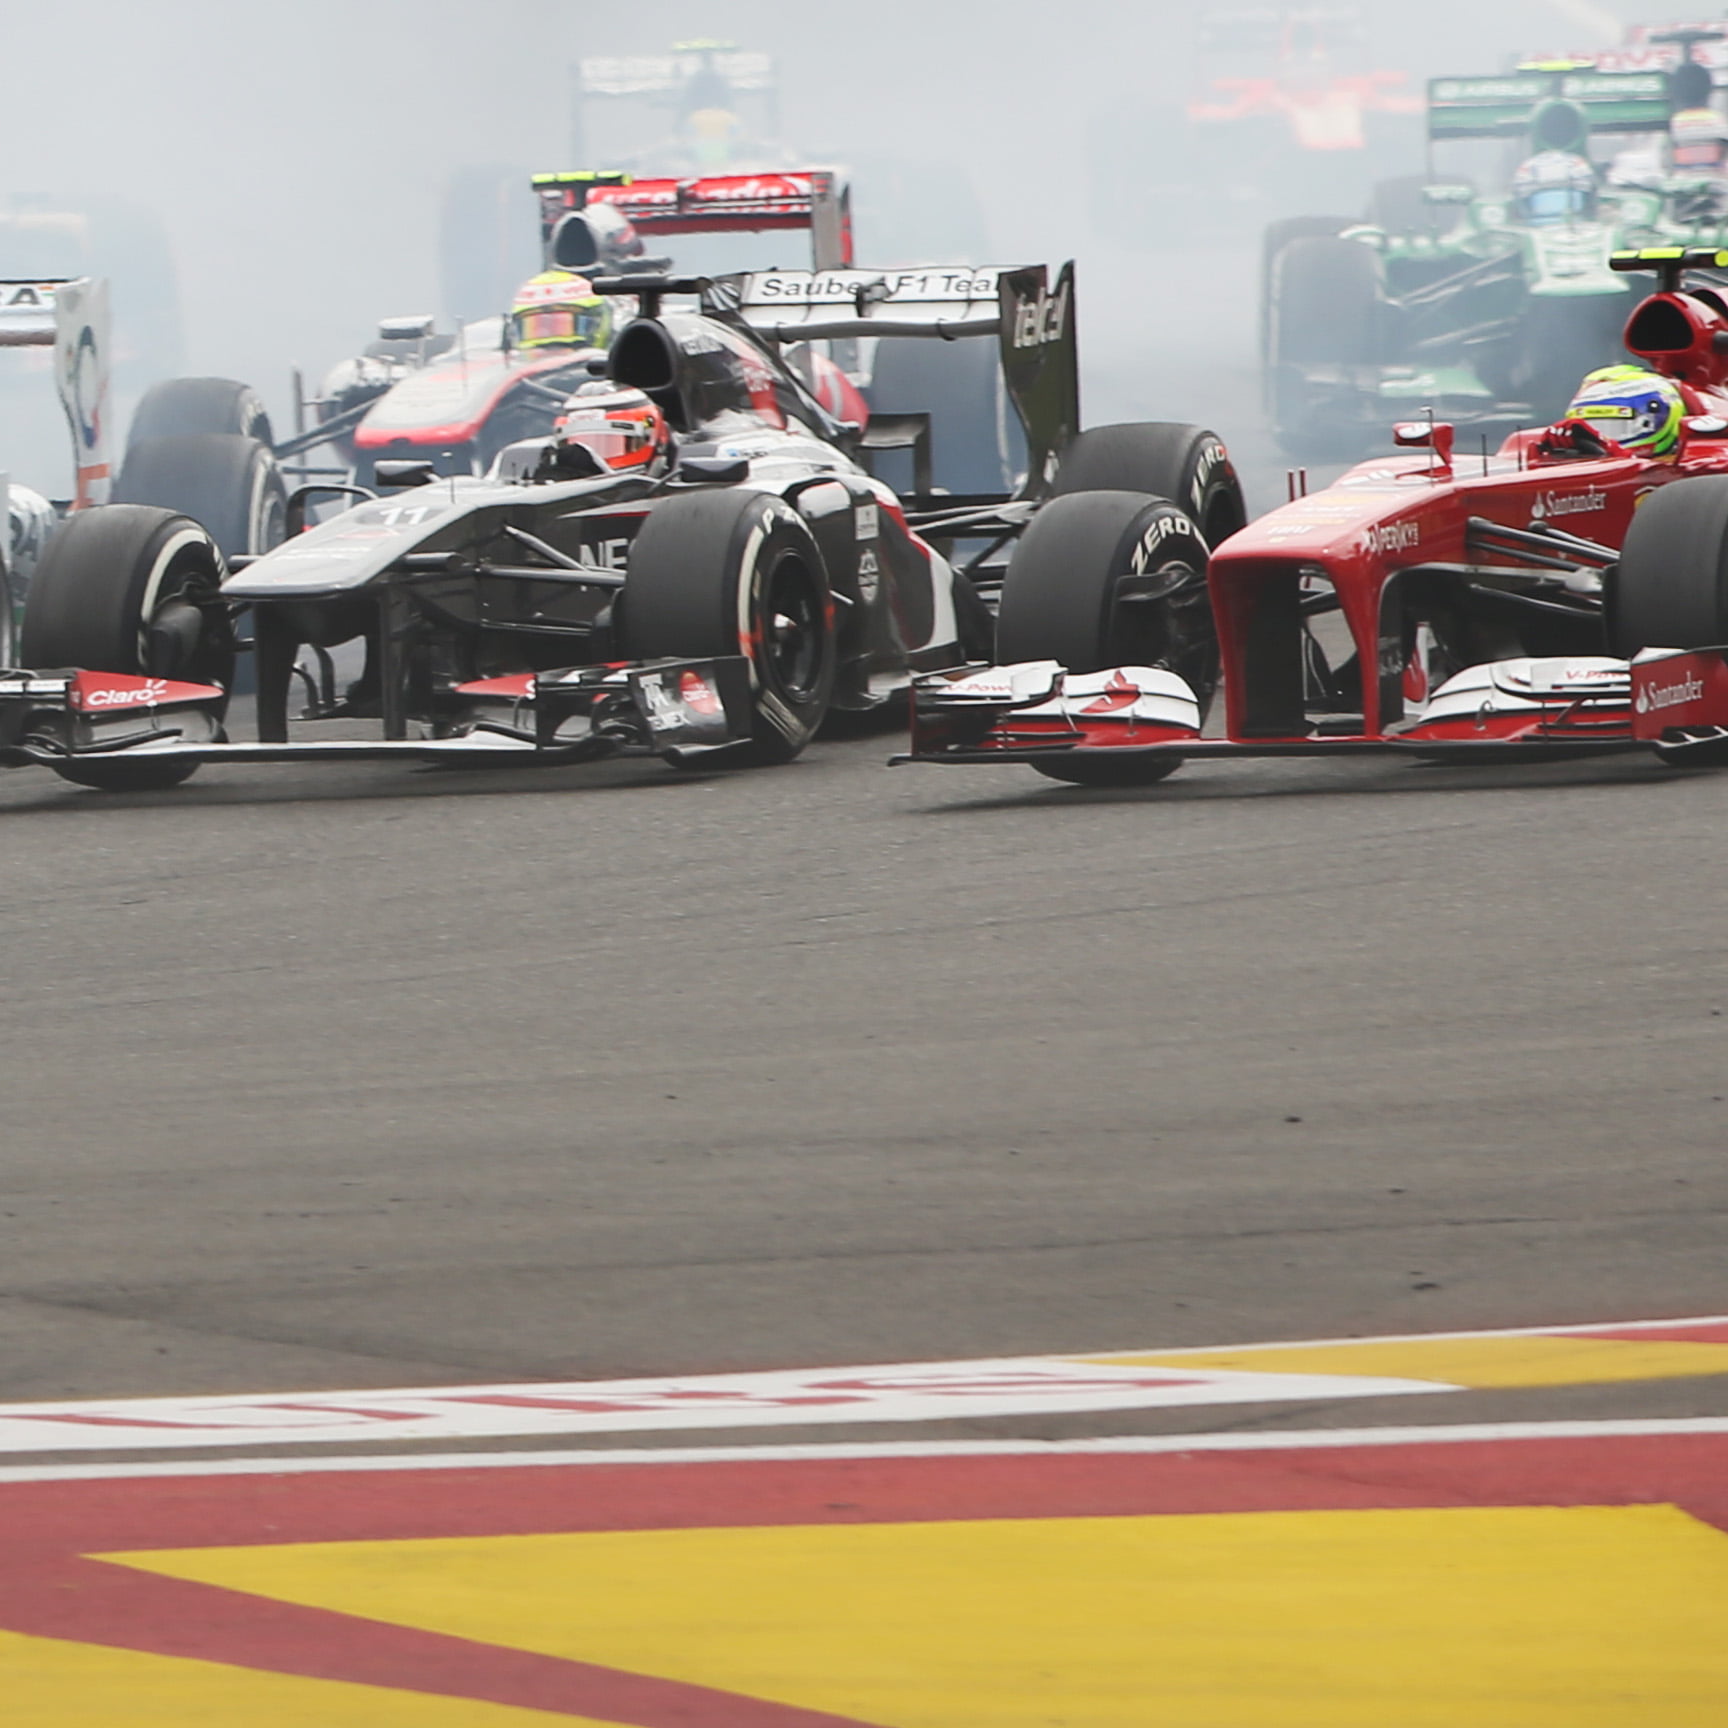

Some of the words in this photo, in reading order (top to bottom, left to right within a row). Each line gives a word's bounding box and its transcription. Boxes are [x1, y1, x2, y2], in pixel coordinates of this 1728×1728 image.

[896, 275, 930, 294] F1
[1545, 488, 1607, 518] Santander
[1129, 513, 1192, 577] ZERO
[86, 688, 154, 706] Claro
[1648, 671, 1705, 711] Santander
